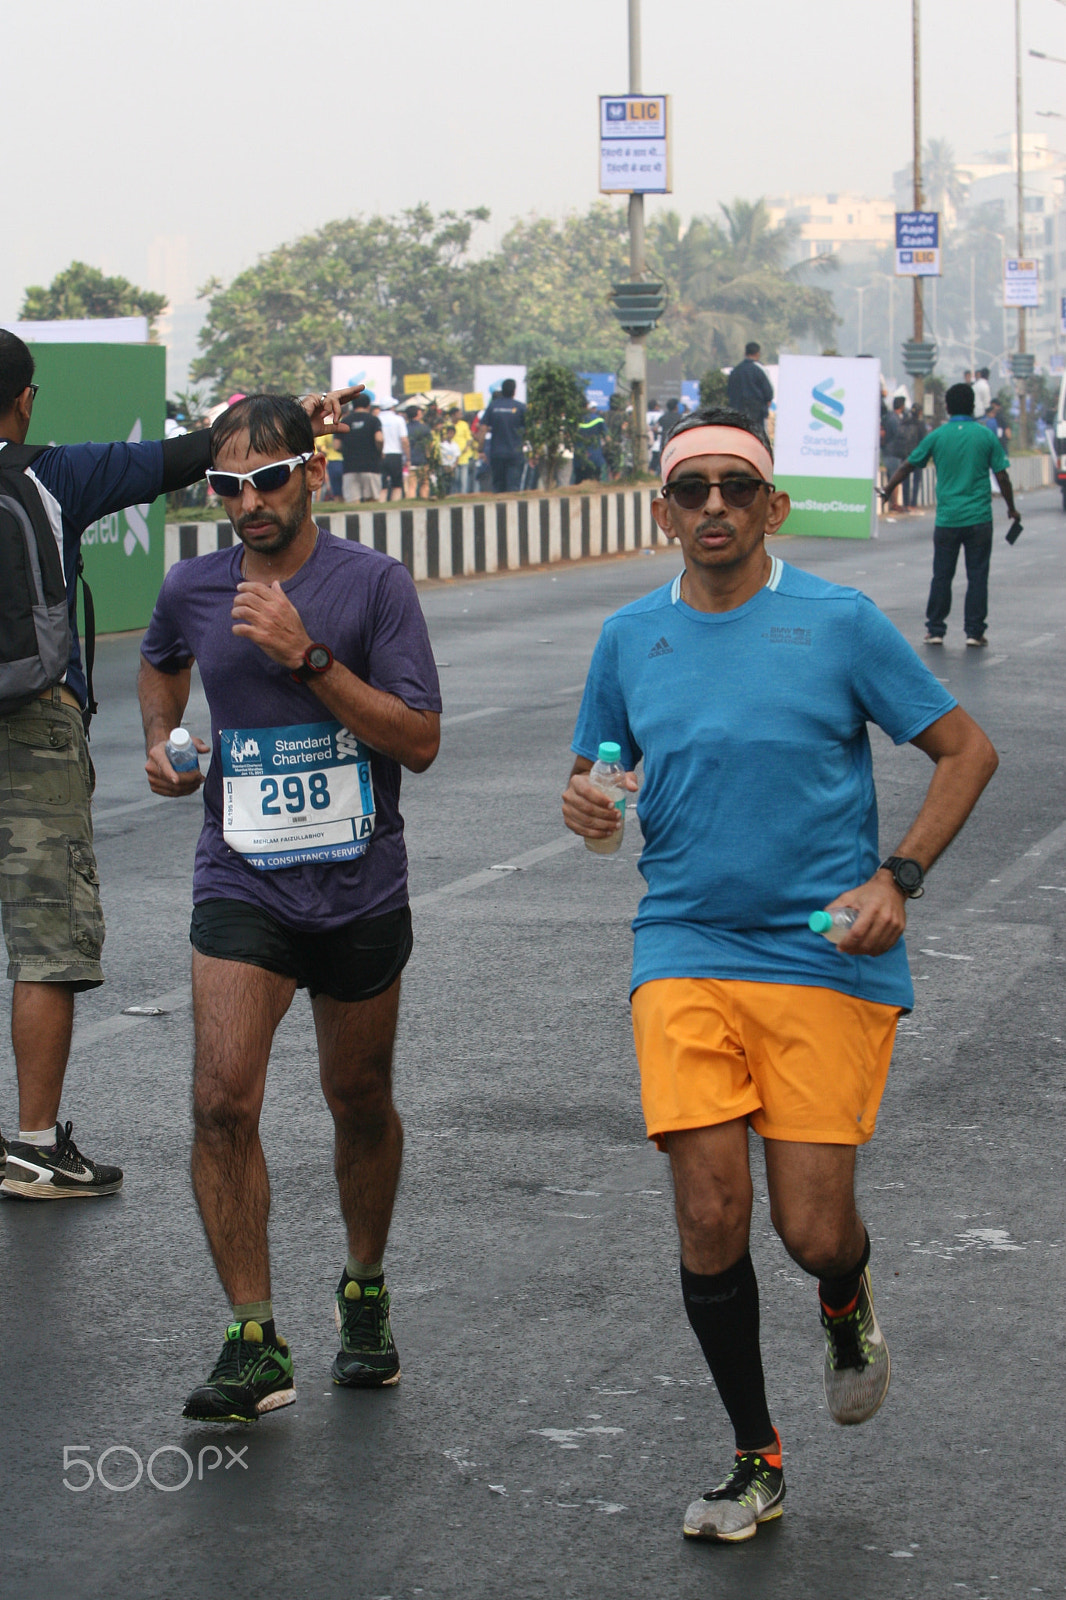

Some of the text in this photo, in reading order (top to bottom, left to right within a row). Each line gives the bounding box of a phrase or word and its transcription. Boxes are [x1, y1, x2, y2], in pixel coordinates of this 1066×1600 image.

[630, 103, 657, 119] LIC
[899, 223, 935, 235] Aapke
[902, 235, 934, 246] Saath
[915, 252, 934, 262] LIC
[803, 434, 848, 447] Standard
[800, 446, 849, 459] Chartered
[790, 499, 867, 513] neStepCloser
[647, 647, 674, 660] adidas
[275, 734, 331, 752] Standard
[272, 748, 333, 766] Chartered
[359, 763, 370, 784] 6
[260, 772, 331, 816] 298
[359, 816, 373, 838] A
[253, 832, 325, 845] MEHLAM FAIZULLABHOY
[267, 851, 330, 866] CONSULTANCY
